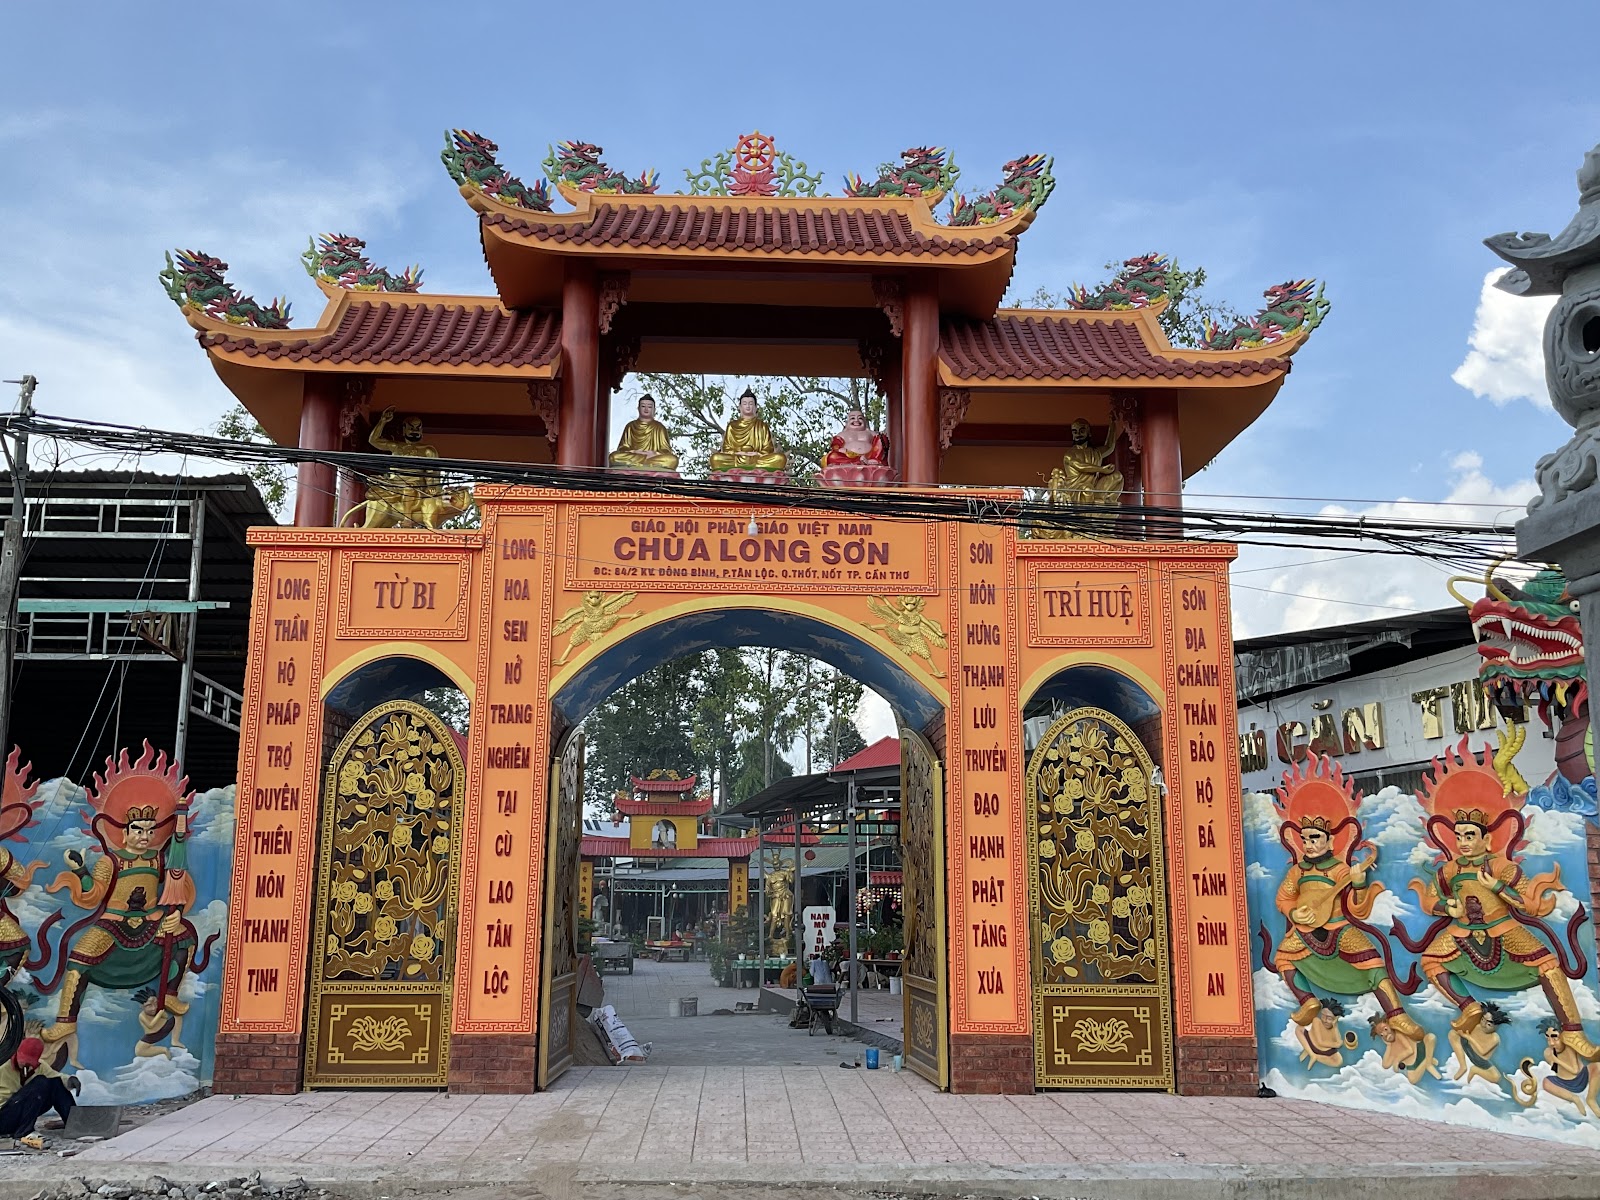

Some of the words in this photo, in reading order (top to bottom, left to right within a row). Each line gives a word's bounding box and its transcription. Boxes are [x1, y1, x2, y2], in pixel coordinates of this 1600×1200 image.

[632, 519, 665, 532] GIÁO
[673, 519, 698, 536] HỘI
[708, 520, 745, 535] PHẬT
[756, 521, 788, 536] GIÁO
[798, 521, 829, 537] VIỆT
[839, 524, 872, 535] NAM
[503, 539, 536, 560] LONG
[614, 532, 711, 561] CHÙA
[720, 539, 810, 563] LONG
[822, 538, 888, 565] SƠN
[970, 540, 992, 564] SƠN
[615, 567, 638, 575] 84/2
[722, 568, 751, 579] P.TÂN
[755, 568, 777, 579] LỘC.
[822, 568, 841, 578] NỐT
[847, 571, 861, 579] TP.
[890, 571, 909, 579] THƠ
[277, 578, 310, 600] LONG
[375, 573, 408, 609] TỪ
[412, 582, 436, 609] BI
[504, 579, 530, 600] HOA
[968, 579, 995, 604] MÔN
[1182, 586, 1206, 610] SƠN
[1043, 581, 1082, 618] TRÍ
[1087, 583, 1133, 625] HUỆ
[275, 614, 308, 641] THẦN
[504, 620, 527, 641] SEN
[967, 620, 1000, 645] HƯNG
[1186, 628, 1206, 652] ĐỊA
[278, 657, 295, 686] HỘ
[505, 655, 522, 684] NỞ
[961, 662, 1004, 692] THẠNH
[1178, 660, 1219, 687] CHÁNH
[267, 700, 300, 725] PHÁP
[491, 704, 532, 724] TRANG
[974, 703, 996, 728] LƯU
[1184, 698, 1216, 725] THẦN
[268, 742, 292, 770] TRỢ
[487, 742, 530, 769] NGHIÊM
[965, 742, 1006, 774] TRUYỀN
[1190, 732, 1214, 762] BẢO
[255, 783, 299, 811] DUYÊN
[497, 791, 517, 816] TẠI
[974, 793, 999, 817] ĐẠO
[1196, 777, 1213, 807] HỘ
[254, 824, 292, 854] THIỀN
[496, 830, 512, 856] CÙ
[1199, 820, 1215, 847] BÁ
[970, 836, 1004, 861] HẠNH
[256, 870, 285, 898] MÔN
[489, 881, 513, 903] LAO
[972, 876, 1004, 906] PHẬT
[1192, 867, 1227, 896] TÁNH
[811, 913, 830, 921] NAM
[814, 920, 827, 928] MÔ
[1197, 915, 1227, 945] BÌNH
[243, 919, 289, 943] THANH
[487, 919, 512, 947] TÂN
[973, 920, 1006, 947] TĂNG
[248, 969, 278, 995] TỊNH
[484, 965, 508, 998] LỘC
[978, 966, 1003, 994] XƯA
[1208, 973, 1224, 996] AN
